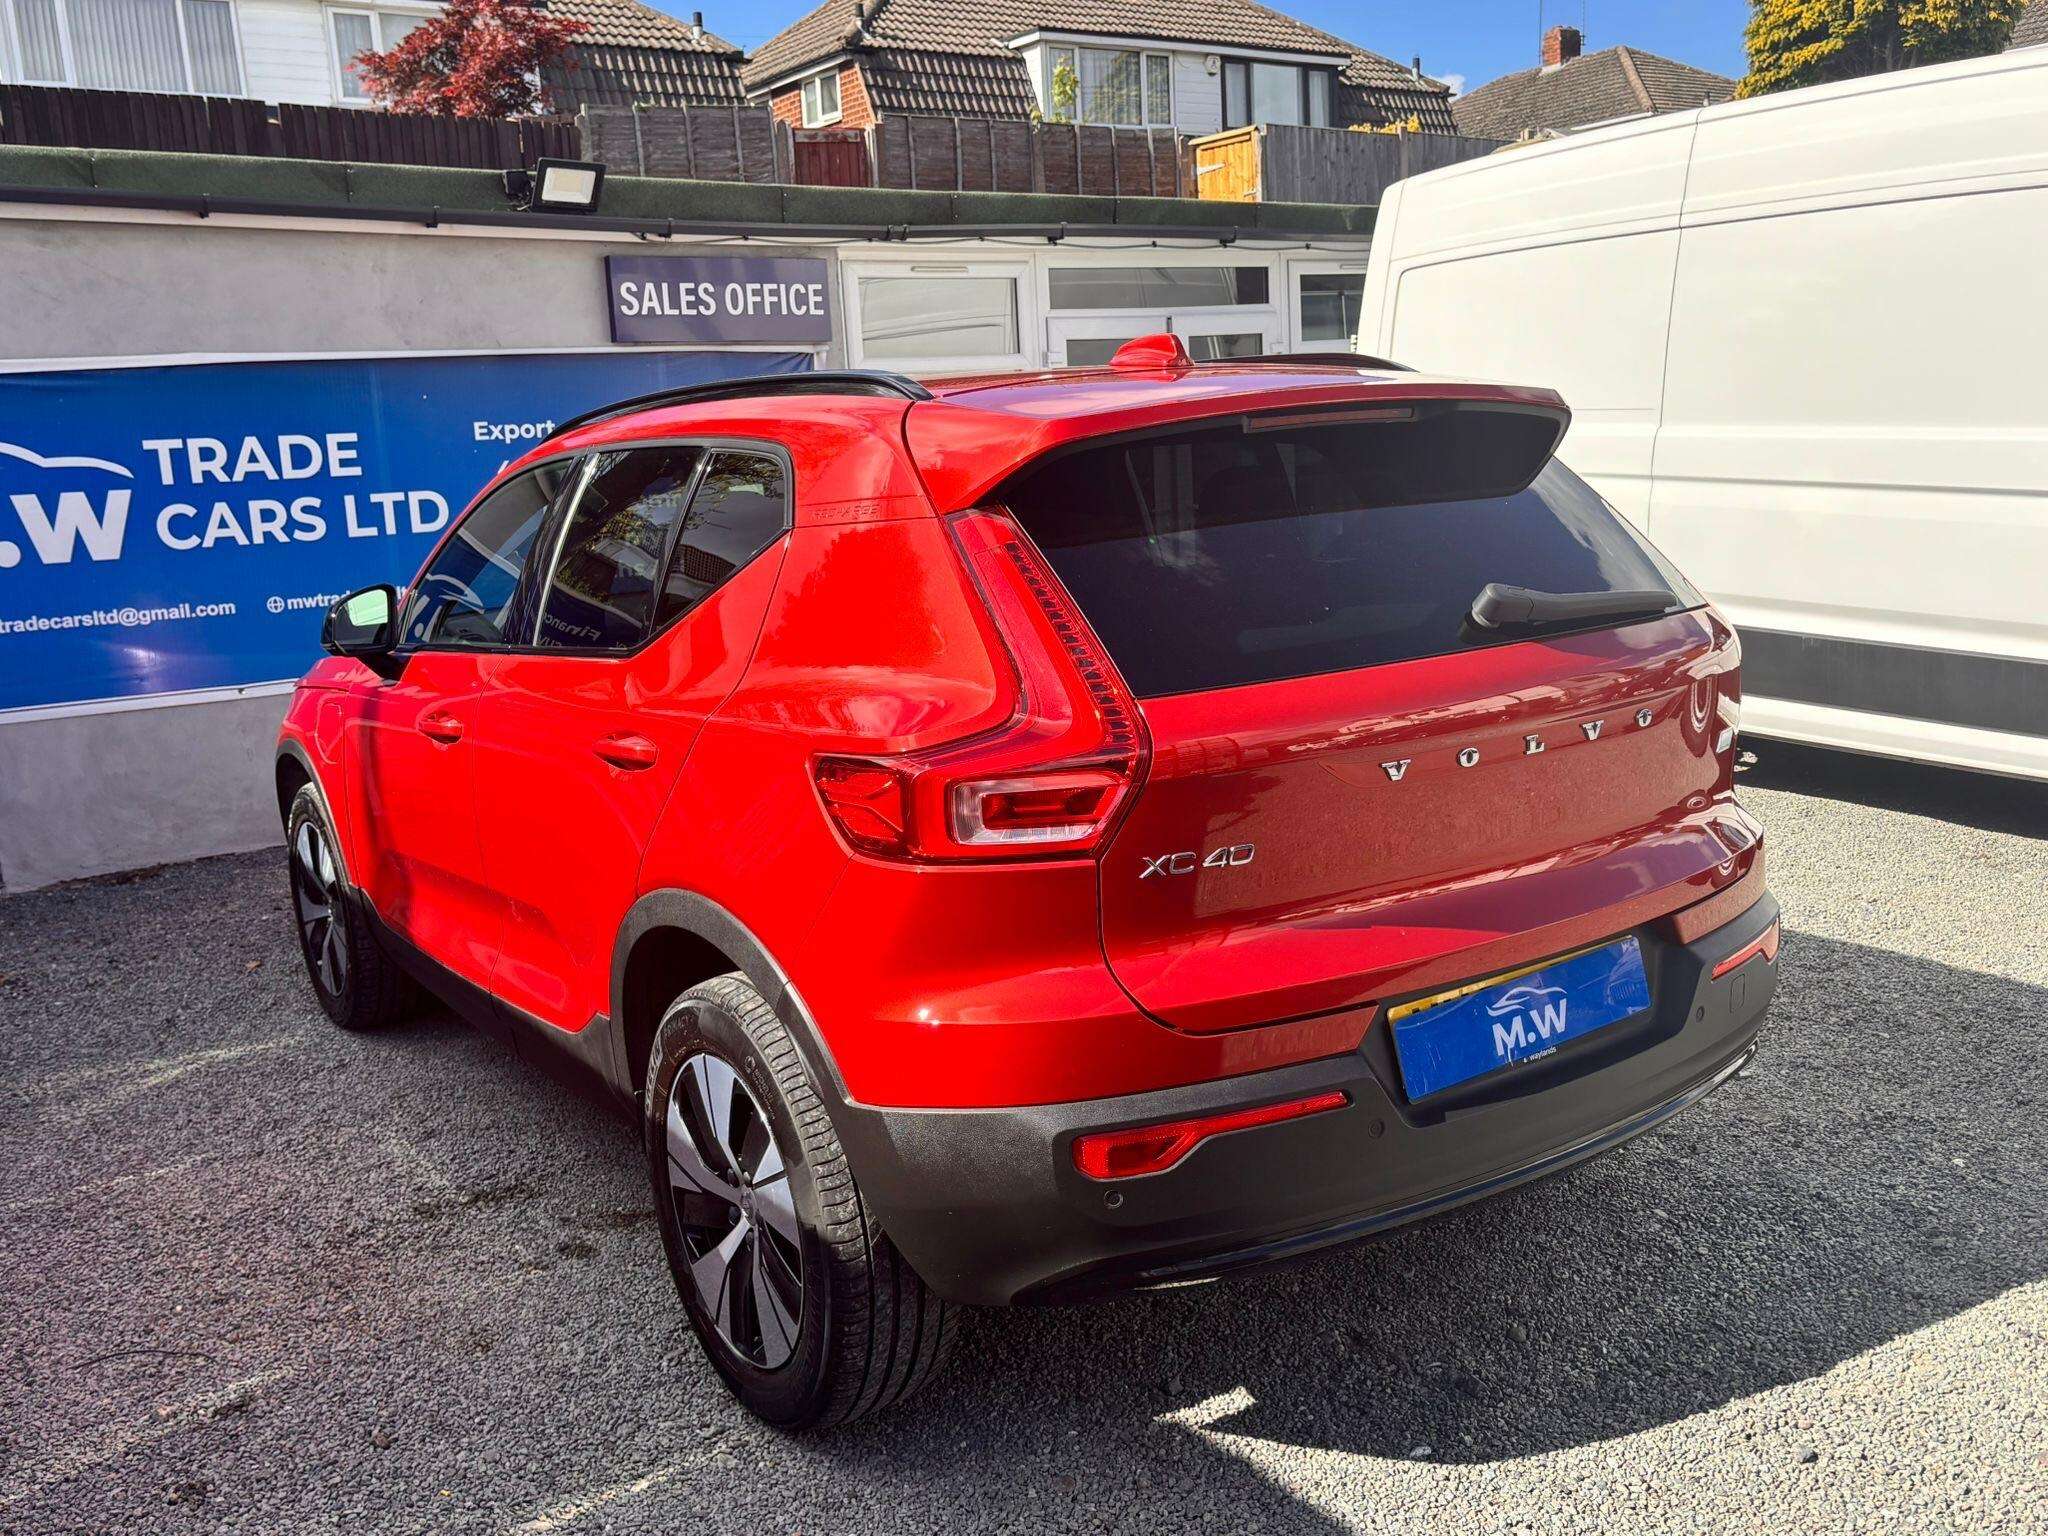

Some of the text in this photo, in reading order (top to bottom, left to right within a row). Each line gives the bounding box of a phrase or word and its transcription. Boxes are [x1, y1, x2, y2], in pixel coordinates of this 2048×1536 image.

[619, 281, 825, 316] SALES OFFICE
[473, 420, 556, 443] Export
[142, 432, 363, 485] TRADE
[156, 490, 450, 550] CARS LTD
[0, 602, 236, 634] tradecarsltd@gmail.com
[1381, 707, 1654, 782] VOLVO
[1492, 998, 1567, 1056] M.W
